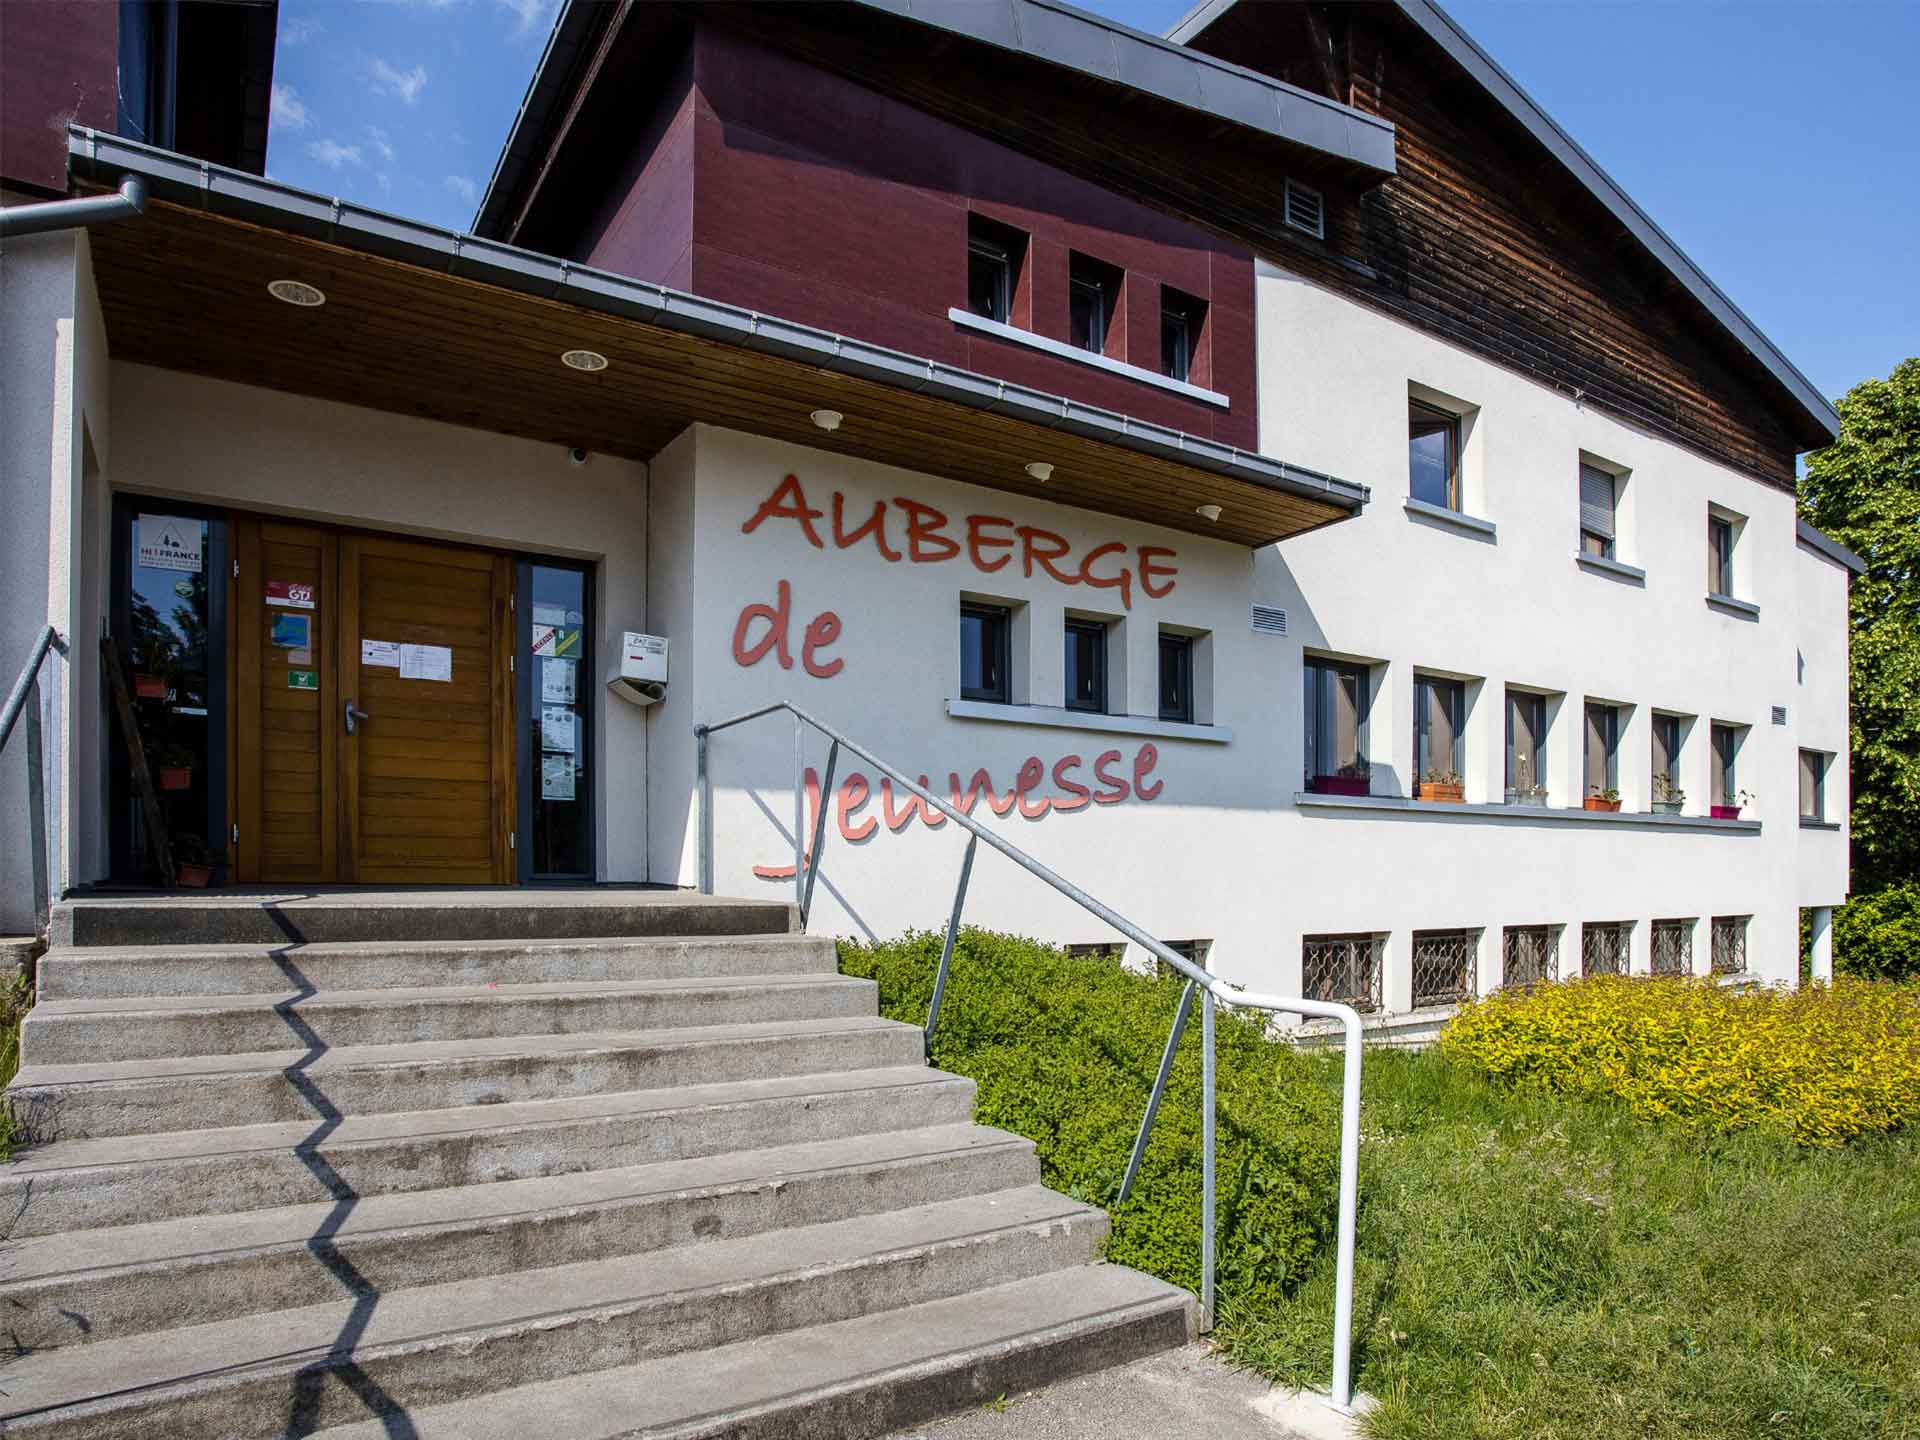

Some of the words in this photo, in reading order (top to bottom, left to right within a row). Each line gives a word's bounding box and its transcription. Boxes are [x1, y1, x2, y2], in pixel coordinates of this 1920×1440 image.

[160, 550, 201, 561] FRANCE
[742, 474, 1178, 610] AUBERGE
[732, 579, 844, 678] de
